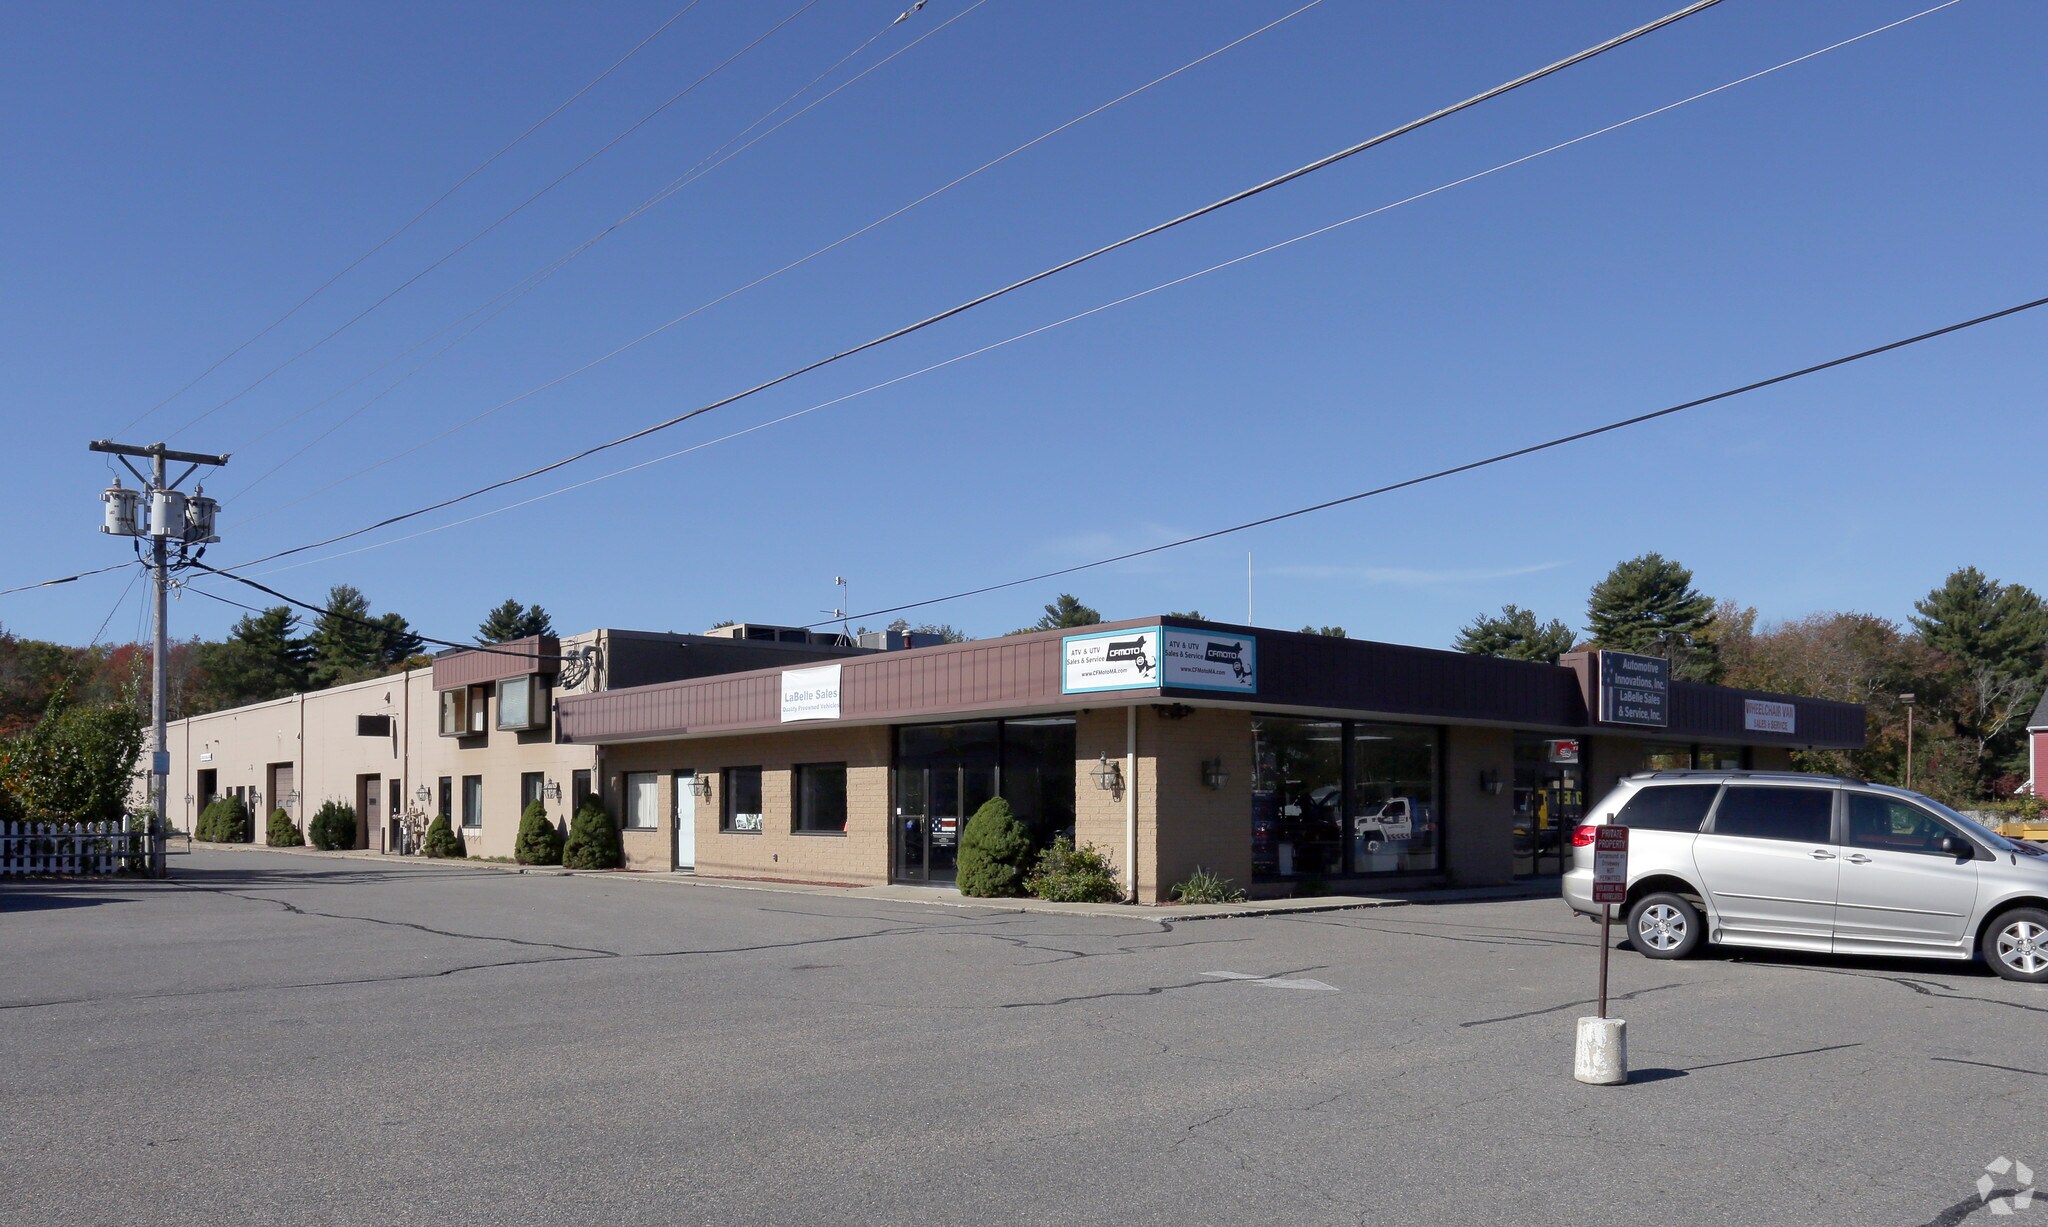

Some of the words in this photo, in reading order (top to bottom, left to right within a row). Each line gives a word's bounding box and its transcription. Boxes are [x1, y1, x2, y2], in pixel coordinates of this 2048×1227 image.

[1109, 647, 1140, 656] CFMOTO
[1208, 650, 1236, 658] CFMOTO
[1623, 658, 1659, 673] Automotive
[1615, 673, 1653, 690] Innovations,
[1654, 678, 1664, 689] Inc.
[785, 691, 813, 702] LaBelle
[816, 689, 838, 700] Sales
[1620, 690, 1642, 703] LaBelle
[1644, 693, 1660, 704] Sales
[1619, 706, 1624, 716] &
[1625, 707, 1649, 720] Service,
[1651, 709, 1661, 720] Inc.
[1746, 702, 1781, 717] WHEELCHAIR
[1782, 706, 1793, 718] VAN
[1602, 829, 1622, 839] PRIVATE
[1598, 840, 1625, 848] PROPERTY
